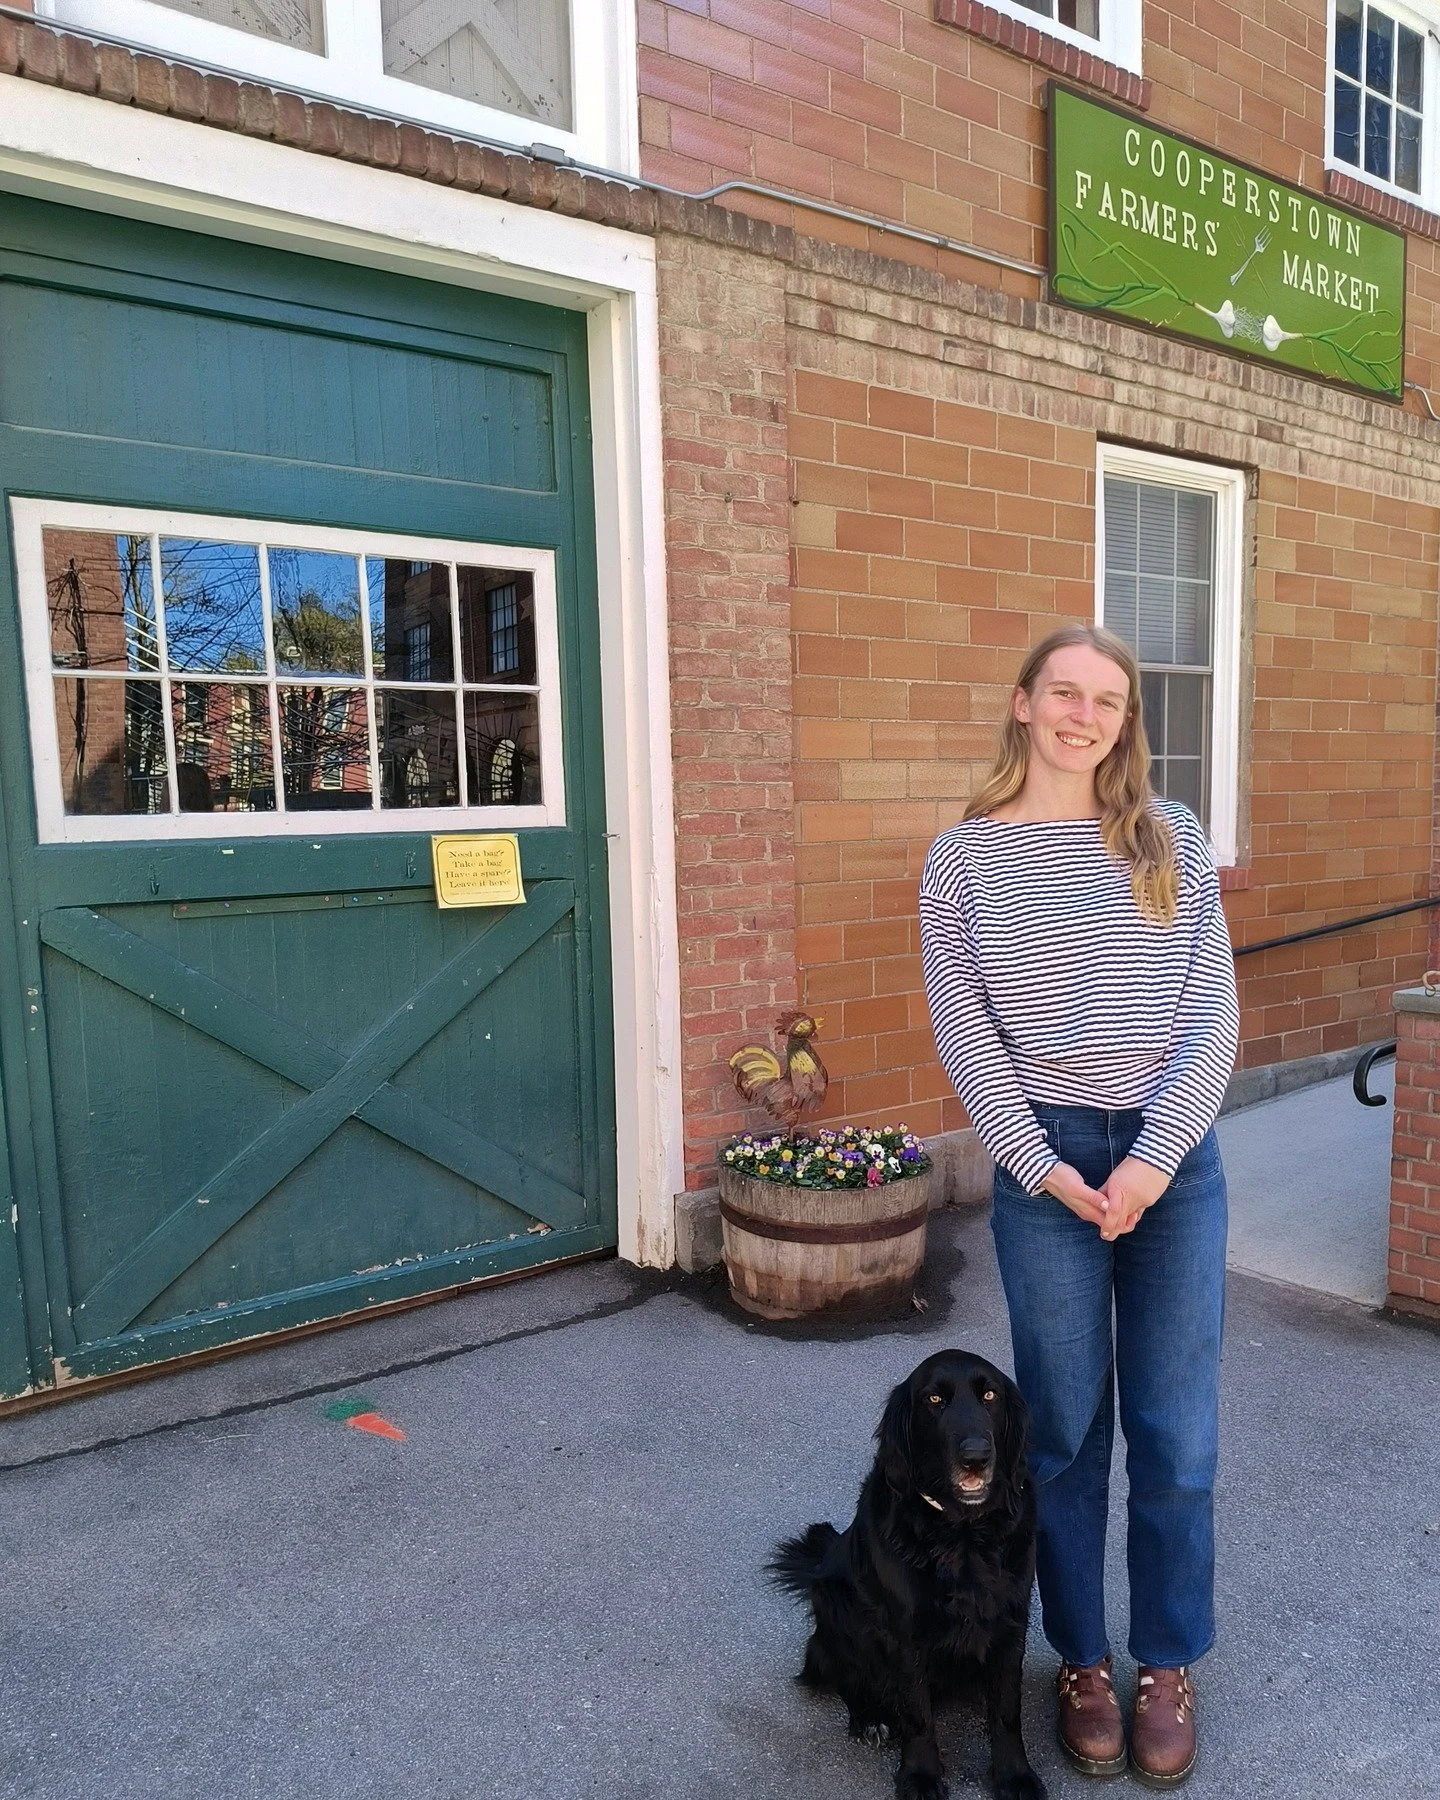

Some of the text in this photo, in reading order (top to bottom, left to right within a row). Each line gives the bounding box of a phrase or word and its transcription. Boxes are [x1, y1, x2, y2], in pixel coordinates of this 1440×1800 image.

[1124, 128, 1361, 257] COOPERSTOWN
[1075, 169, 1379, 316] FARMERS' MARKET
[448, 850, 473, 858] Need
[483, 849, 505, 857] bag?
[452, 860, 476, 868] Take
[480, 869, 511, 878] spare?
